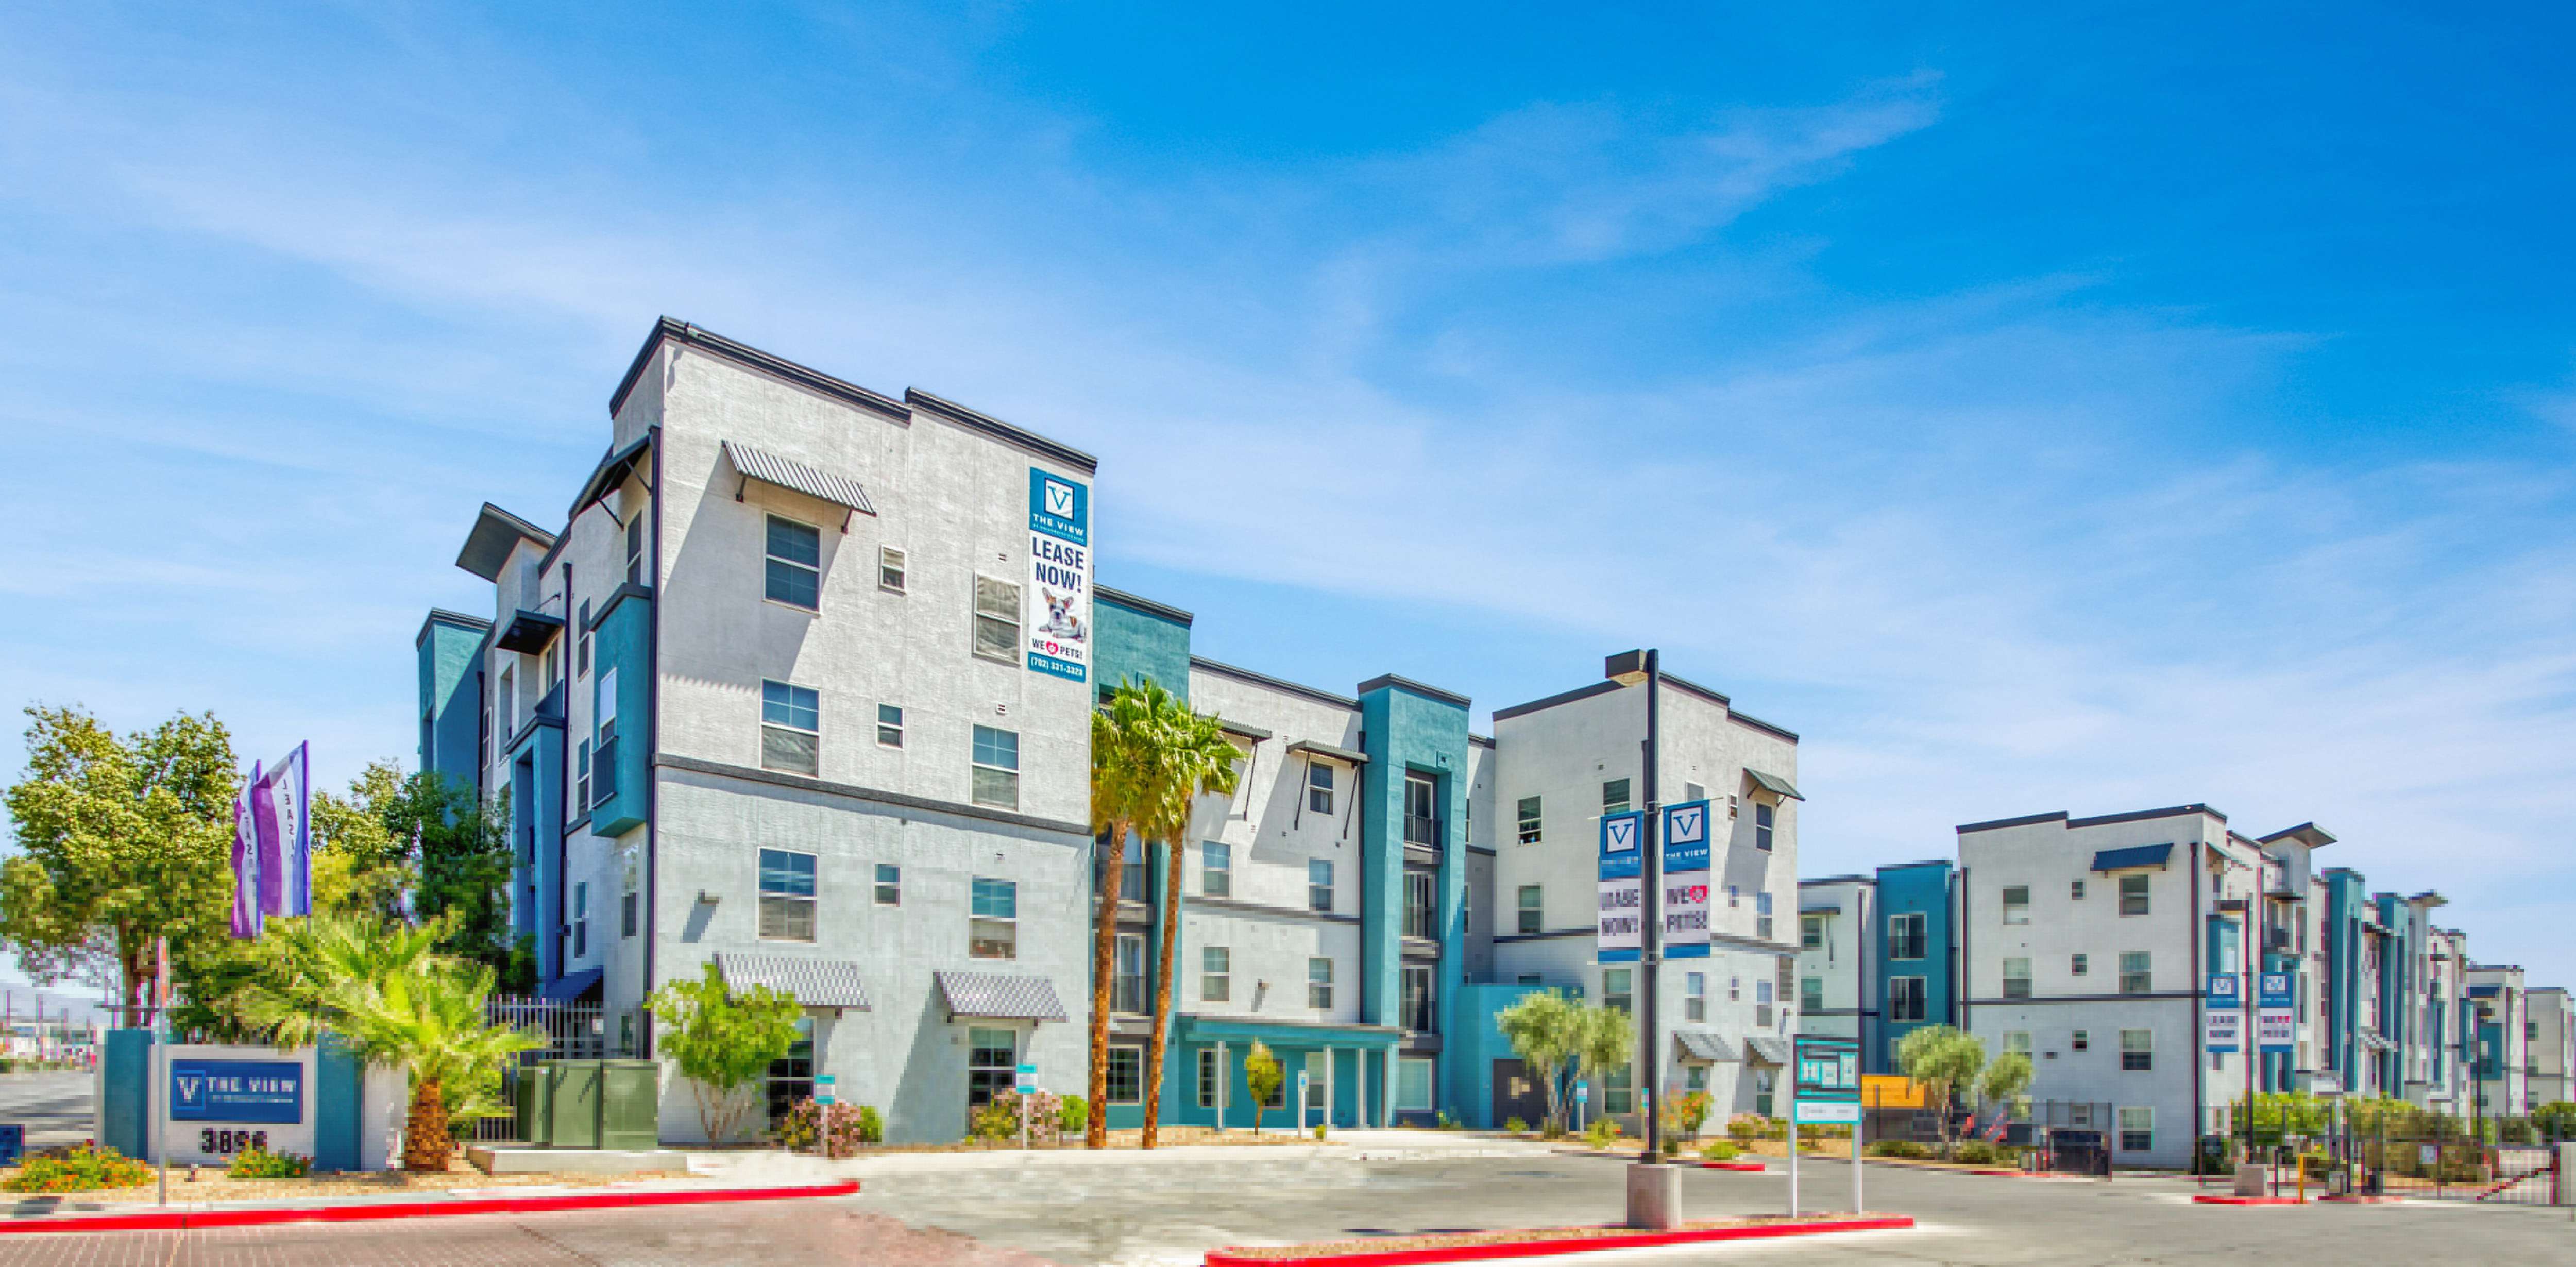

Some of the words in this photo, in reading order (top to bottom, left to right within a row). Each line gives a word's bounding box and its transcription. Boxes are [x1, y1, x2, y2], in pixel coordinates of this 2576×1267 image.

[1047, 486, 1071, 510] V
[1033, 513, 1053, 527] THE
[1057, 521, 1084, 536] VIEW
[1032, 537, 1084, 570] LEASE
[1036, 562, 1081, 593] NOW!
[1032, 638, 1045, 650] WE
[1060, 646, 1082, 659] PETS!
[1608, 823, 1633, 845] V
[1673, 813, 1700, 836] V
[1684, 849, 1708, 857] VIEW
[177, 1077, 201, 1103] V
